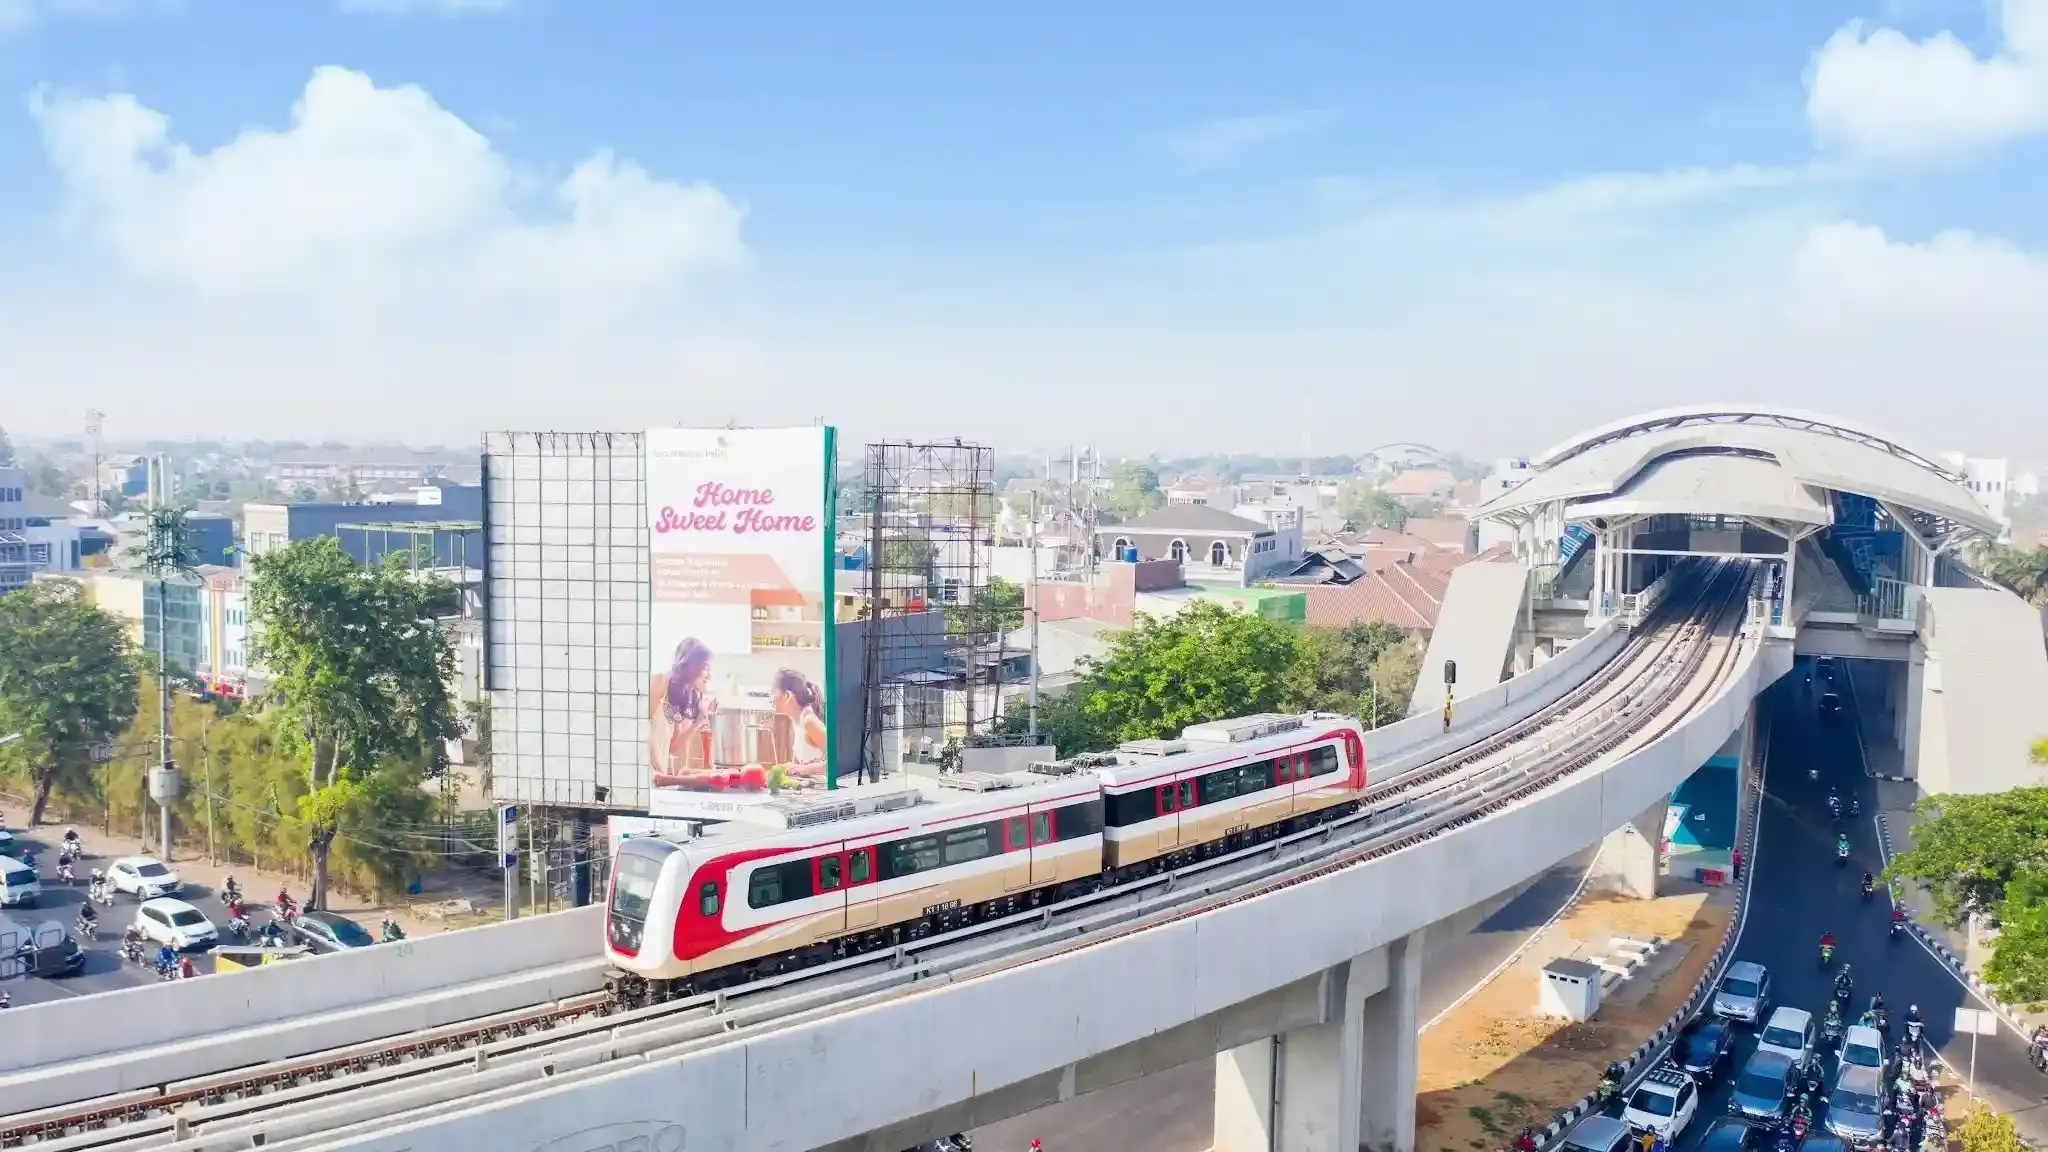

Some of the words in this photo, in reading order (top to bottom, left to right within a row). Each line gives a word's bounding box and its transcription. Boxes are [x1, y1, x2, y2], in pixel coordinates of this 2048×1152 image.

[693, 481, 774, 508] Home
[655, 506, 726, 534] Sweet
[733, 508, 816, 535] Home
